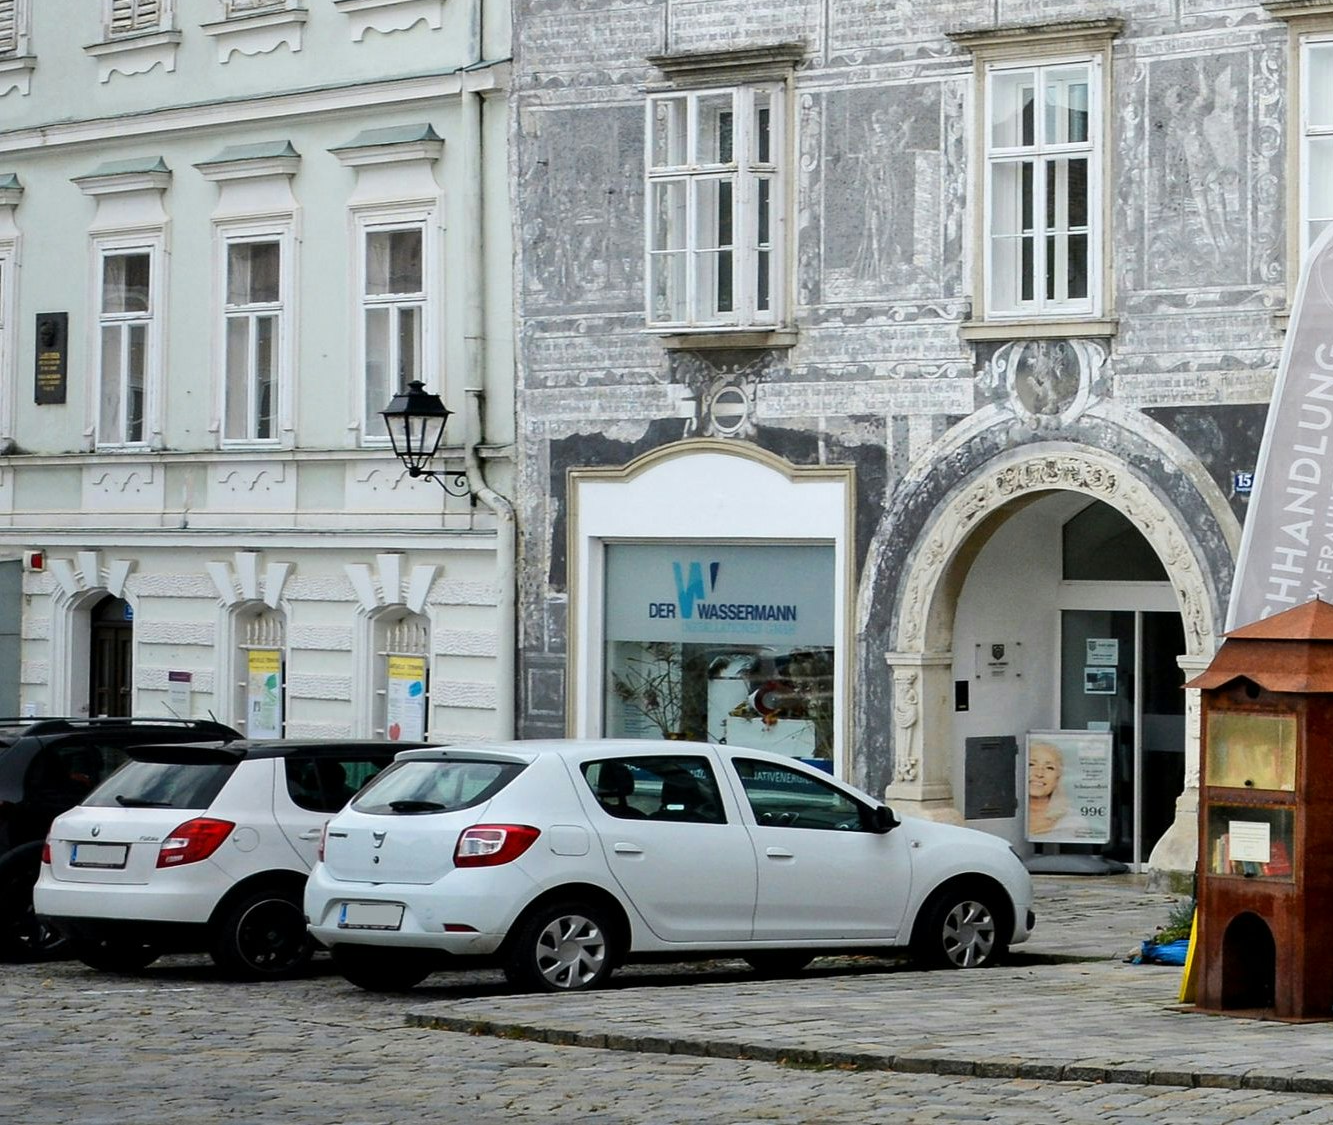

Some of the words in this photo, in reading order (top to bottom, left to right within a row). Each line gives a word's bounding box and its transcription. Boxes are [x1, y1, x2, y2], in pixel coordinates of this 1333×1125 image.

[1237, 474, 1252, 487] 15
[649, 603, 675, 619] DER
[697, 604, 797, 621] WASSERMANN
[1080, 806, 1107, 817] 99€
